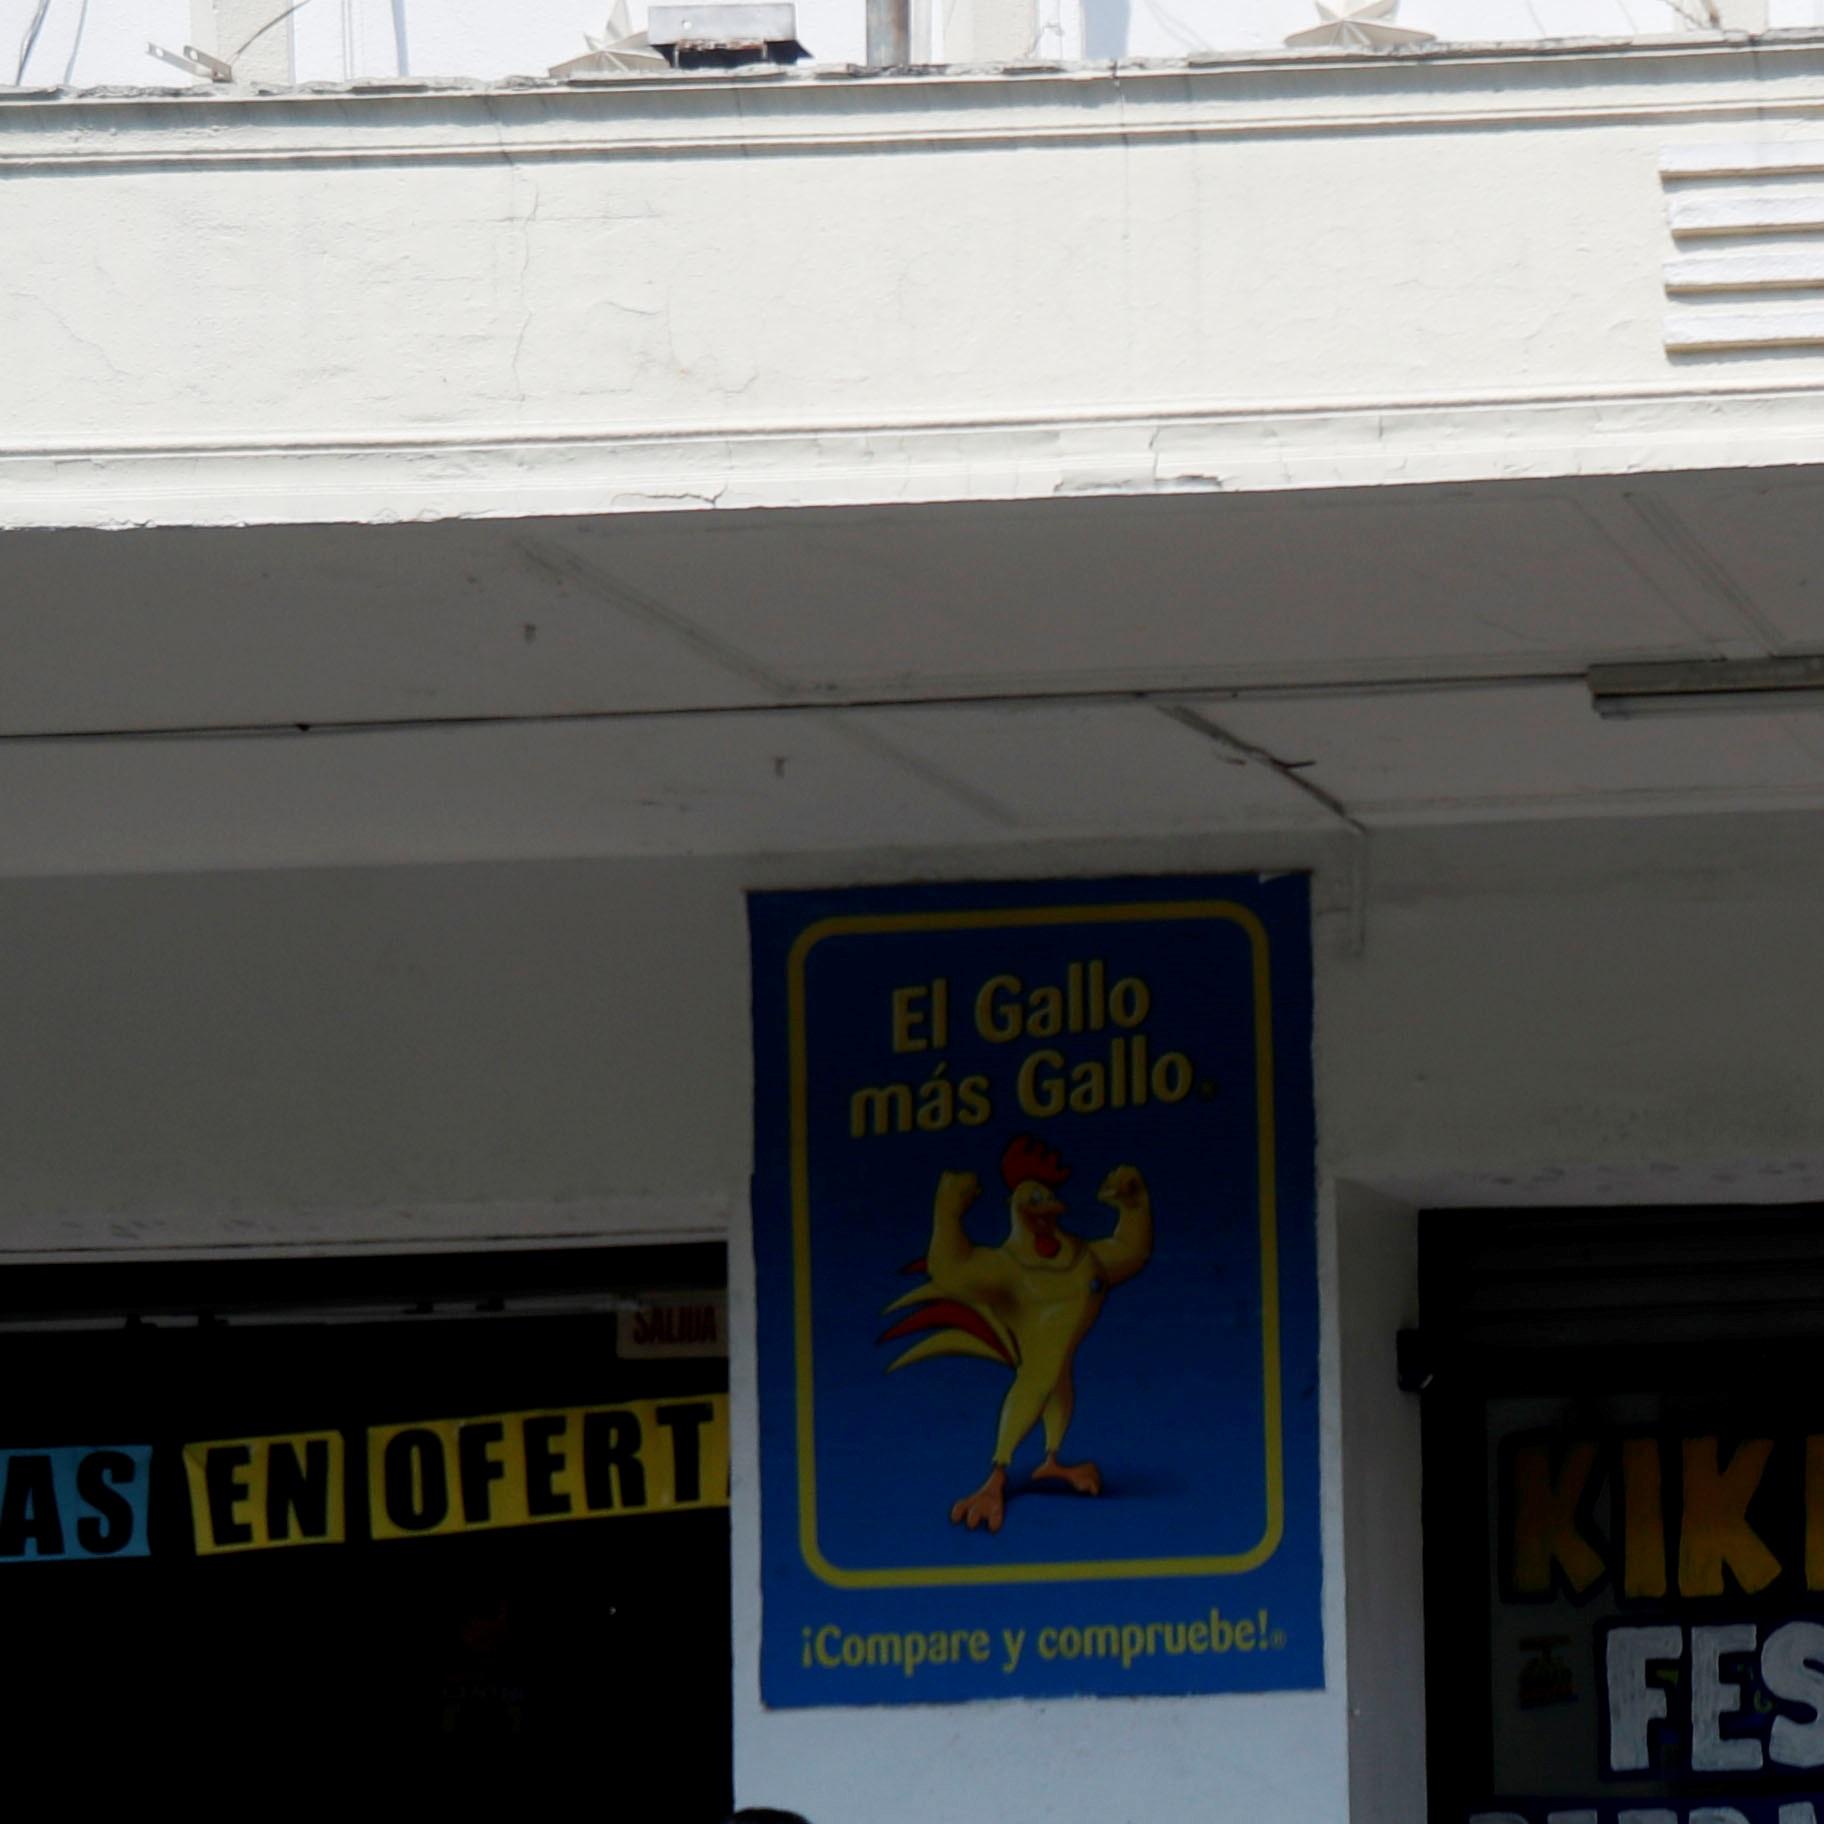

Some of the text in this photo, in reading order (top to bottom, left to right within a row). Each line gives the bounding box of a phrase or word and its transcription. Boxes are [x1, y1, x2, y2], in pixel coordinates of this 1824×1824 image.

[891, 958, 1152, 1055] El Gallo
[848, 1033, 1196, 1139] más Gallo
[205, 1441, 330, 1547] EN
[385, 1402, 731, 1530] OFERT
[801, 1606, 1272, 1679] ¡Compare y compruebe!
